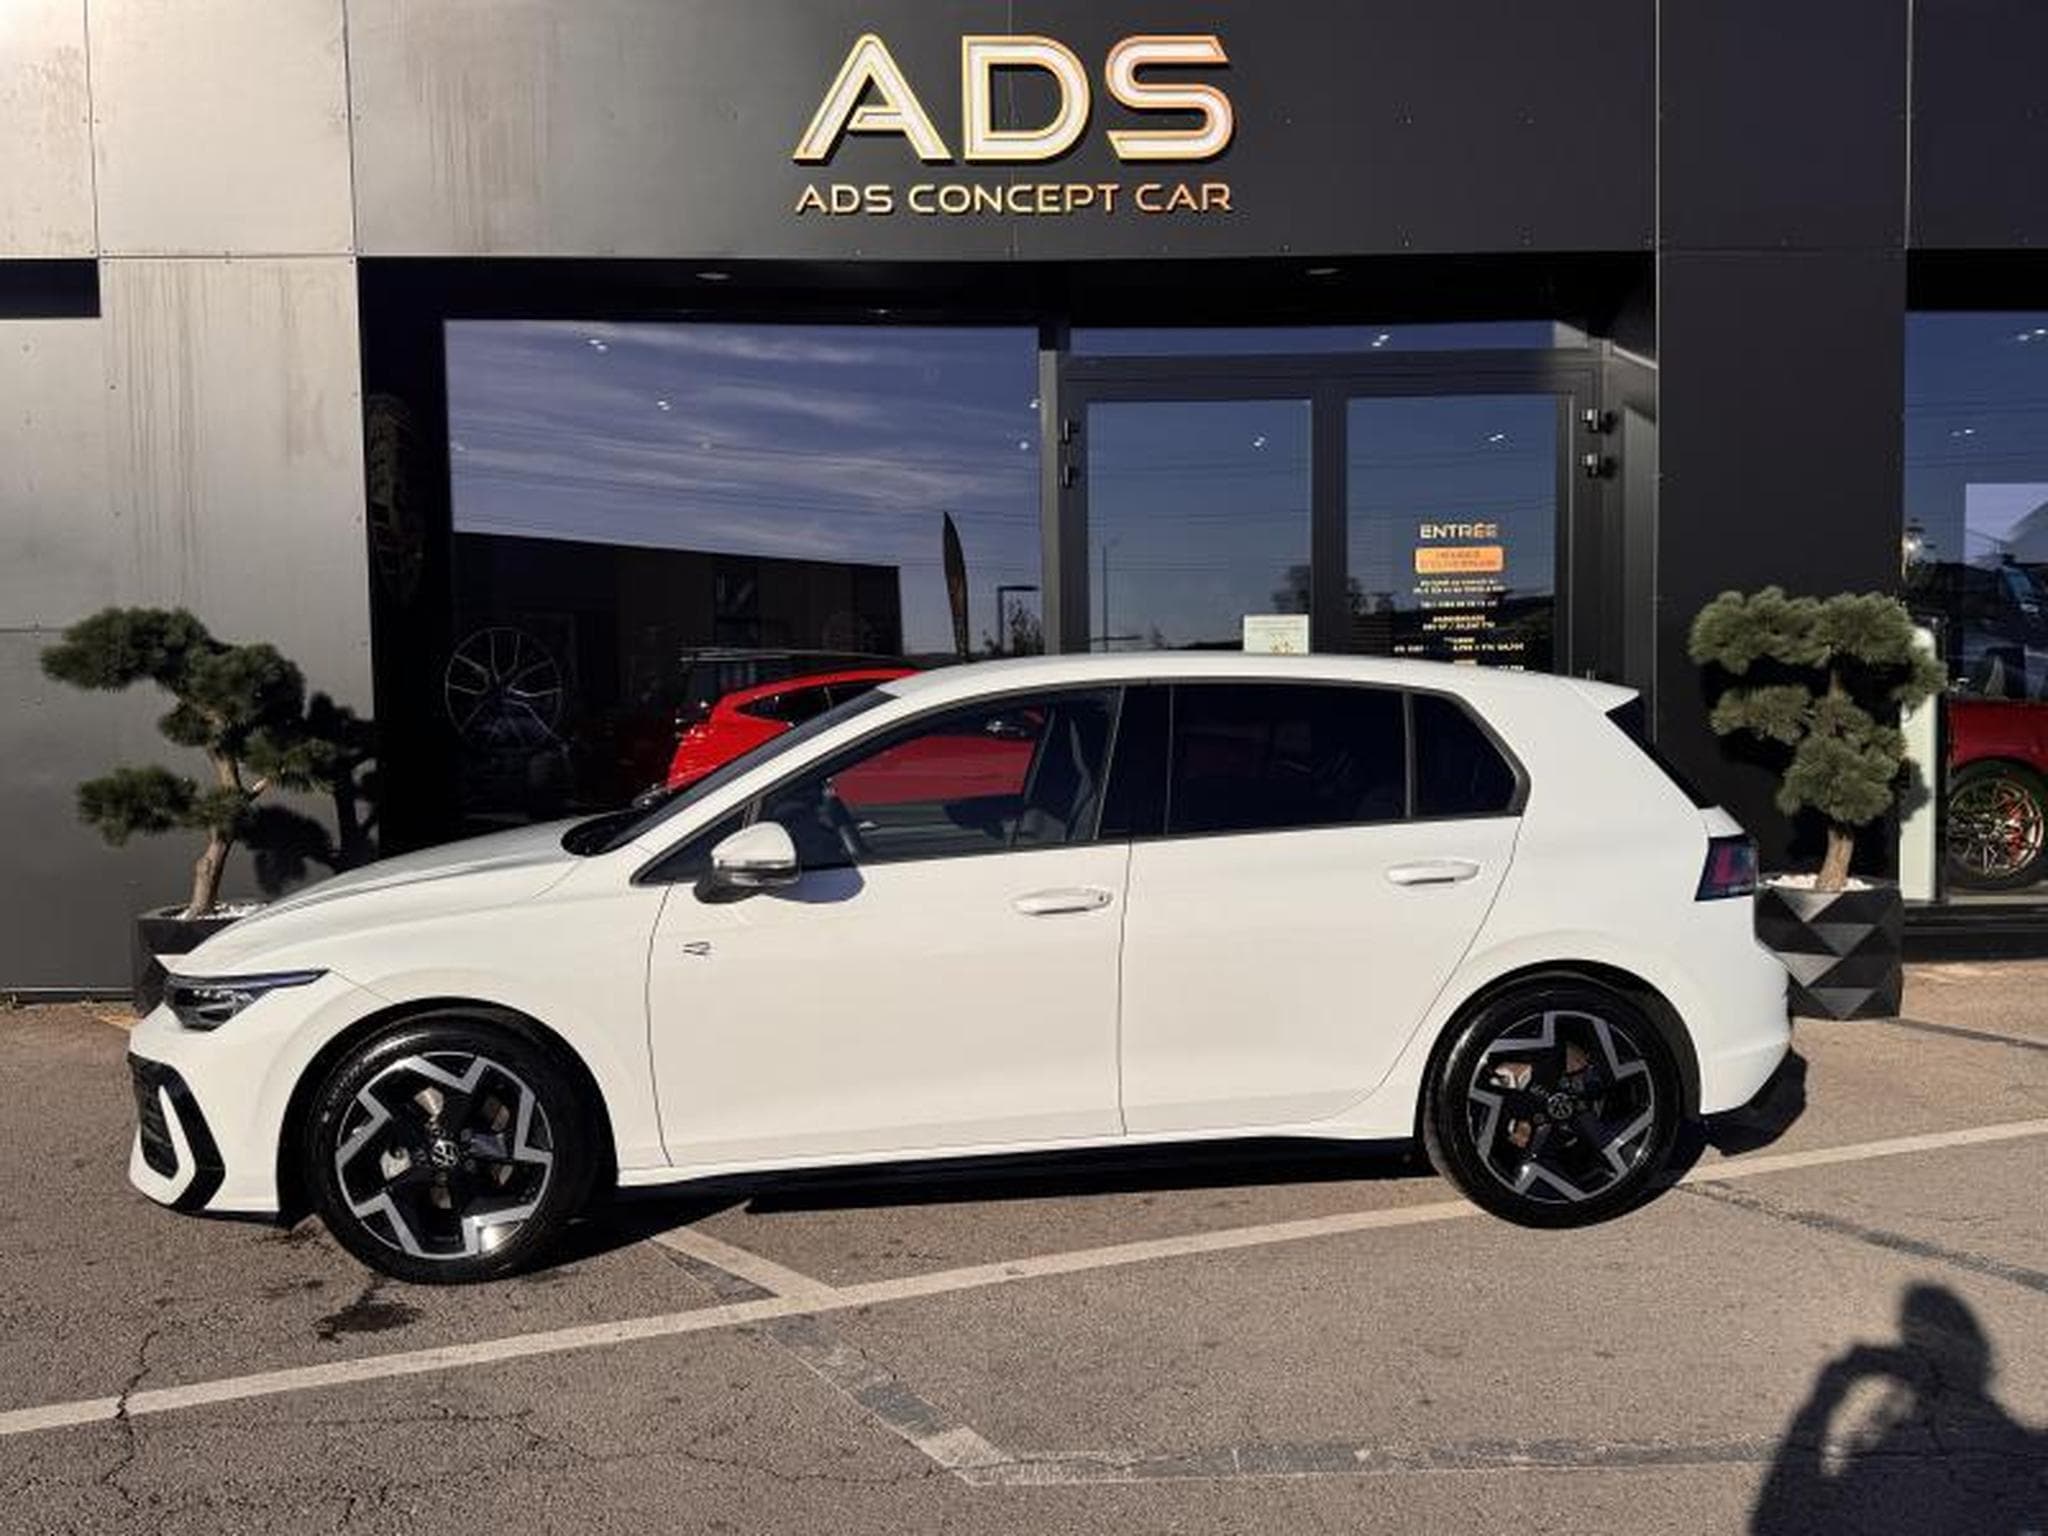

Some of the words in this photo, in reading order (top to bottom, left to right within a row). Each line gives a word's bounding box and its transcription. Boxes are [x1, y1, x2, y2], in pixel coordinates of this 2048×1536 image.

[792, 33, 1235, 162] ADS
[795, 184, 893, 214] ADS
[909, 183, 1120, 214] CONCEPT
[1135, 182, 1232, 212] CAR
